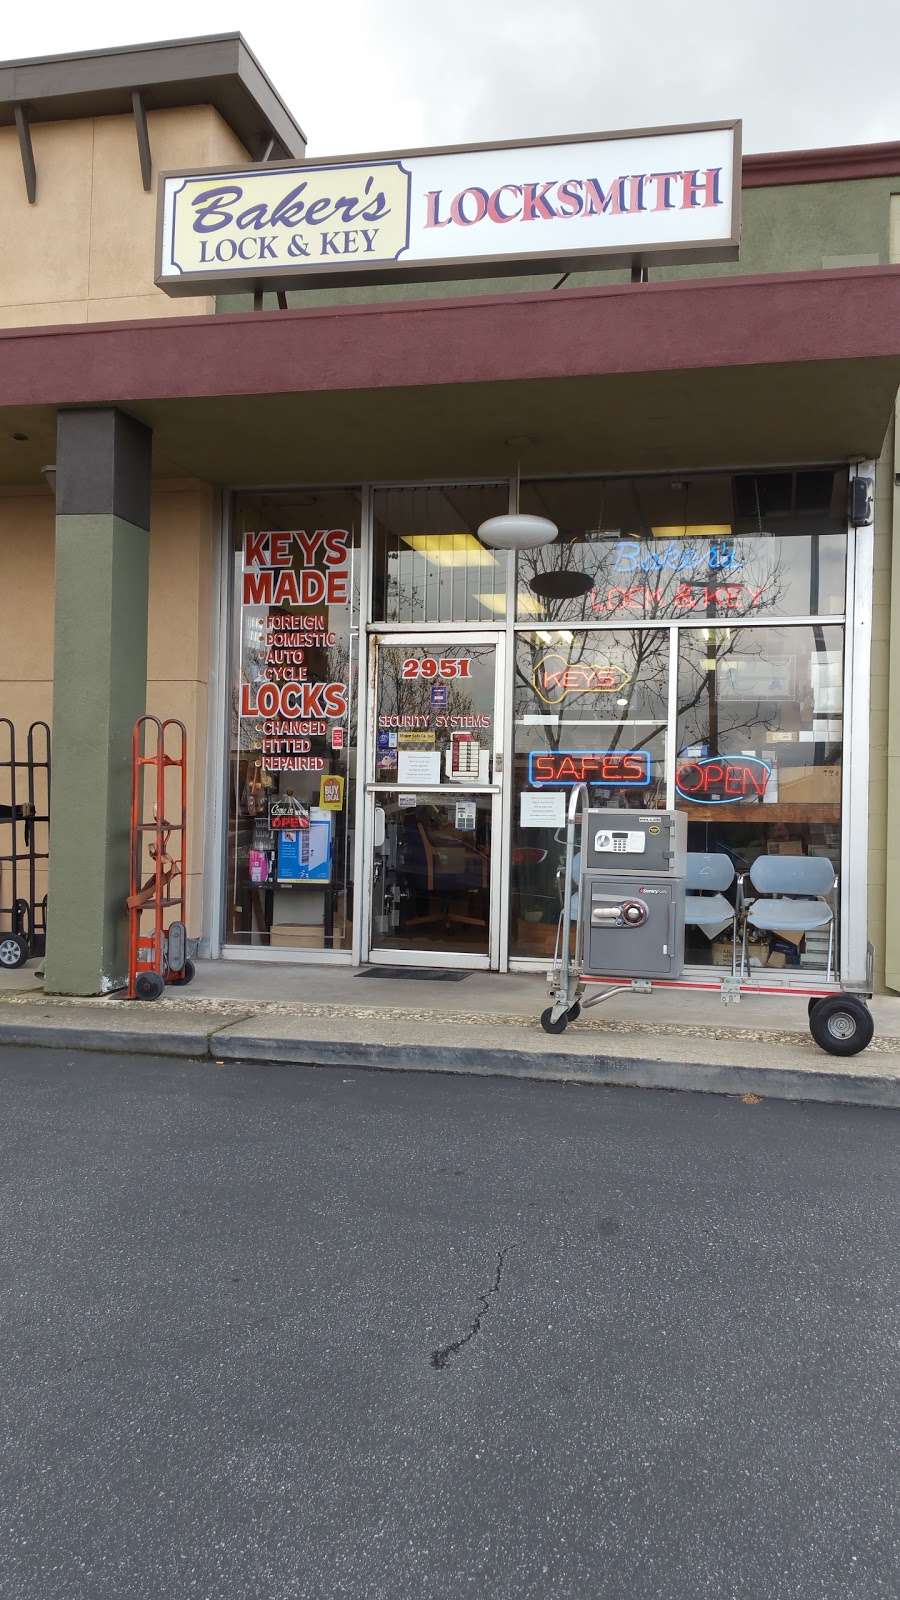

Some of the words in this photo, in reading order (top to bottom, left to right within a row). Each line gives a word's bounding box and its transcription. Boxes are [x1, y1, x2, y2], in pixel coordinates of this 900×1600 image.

[191, 175, 391, 233] Baker's
[422, 167, 723, 230] LOCKSMITH
[199, 234, 279, 263] LOCK
[287, 233, 311, 257] &
[319, 228, 381, 254] KEY
[244, 529, 349, 567] KEYS
[242, 569, 349, 606] MADE
[591, 584, 662, 611] LOCK
[702, 584, 764, 609] KEY
[266, 615, 325, 630] FOREIGN
[265, 632, 336, 648] DOMESTIC
[265, 649, 304, 665] AUTO
[264, 666, 308, 681] CYCLE
[402, 658, 472, 679] 2951
[542, 670, 616, 689] KEYS
[240, 682, 348, 719] LOCKS
[263, 720, 328, 735] CHANGED
[378, 713, 430, 728] SECURITY
[435, 713, 491, 728] SYSTEMS
[262, 738, 311, 753] FITTED
[262, 756, 324, 771] REPAIRED
[536, 755, 643, 780] SAFES
[676, 763, 770, 796] OPEN
[271, 817, 309, 828] OPEN
